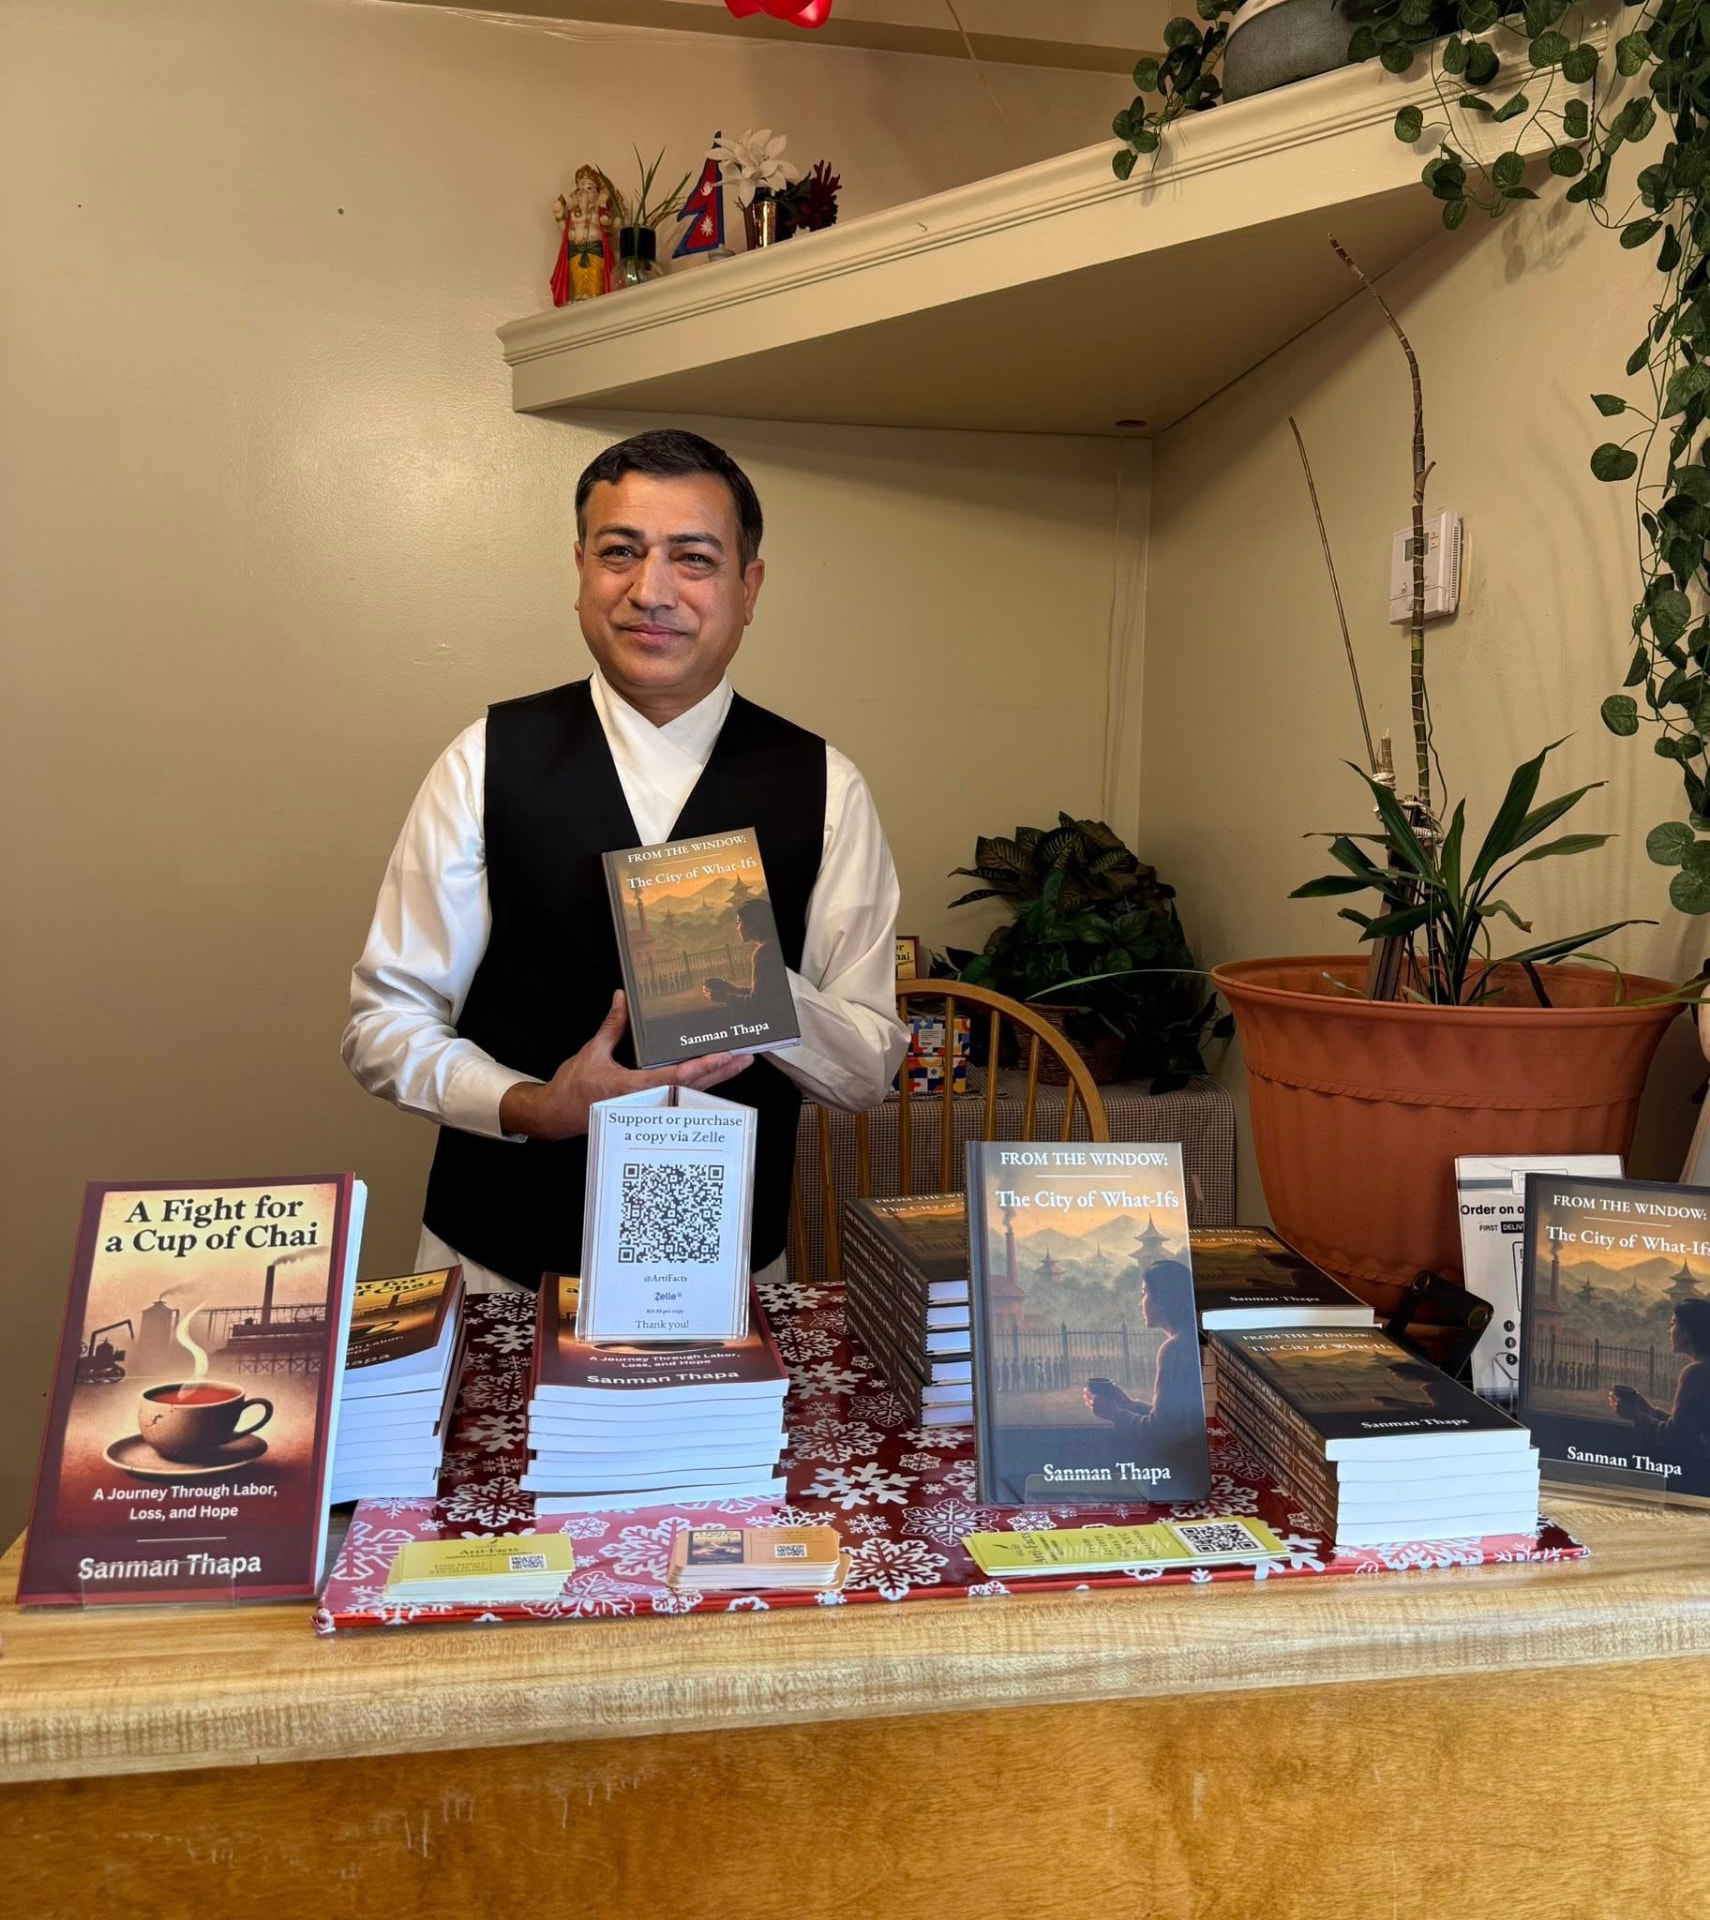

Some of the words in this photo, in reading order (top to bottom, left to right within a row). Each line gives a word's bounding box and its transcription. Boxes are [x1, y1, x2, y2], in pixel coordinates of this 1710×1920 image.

[627, 850, 662, 863] FROM
[664, 845, 689, 857] THE
[691, 835, 747, 852] WINDOW:
[627, 875, 653, 889] The
[655, 872, 683, 885] City
[685, 867, 699, 879] of
[702, 857, 757, 876] What-Ifs
[680, 1030, 728, 1046] Sanman
[730, 1022, 770, 1036] Thapa
[608, 1112, 663, 1127] Support
[666, 1115, 682, 1125] or
[683, 1115, 743, 1128] purchase
[624, 1132, 632, 1141] a
[635, 1133, 668, 1144] copy
[670, 1130, 689, 1142] via
[692, 1131, 726, 1143] Zelle
[1000, 1152, 1048, 1165] FROM
[1052, 1152, 1086, 1165] THE
[1089, 1152, 1168, 1166] WINDOW:
[124, 1200, 152, 1223] A
[161, 1197, 247, 1229] Fight
[254, 1194, 304, 1219] for
[995, 1190, 1030, 1207] The
[1034, 1190, 1073, 1213] City
[1077, 1190, 1097, 1207] of
[1101, 1190, 1180, 1208] What-Ifs
[1460, 1204, 1497, 1215] Order
[1499, 1205, 1515, 1215] on
[1553, 1194, 1596, 1210] FROM
[1599, 1198, 1632, 1213] THE
[1634, 1202, 1708, 1221] WINDOW:
[1479, 1224, 1499, 1232] FIRST
[1545, 1225, 1577, 1243] The
[1580, 1229, 1615, 1249] City
[1619, 1232, 1638, 1248] of
[105, 1235, 124, 1253] a
[133, 1229, 198, 1258] Cup
[205, 1225, 242, 1250] of
[245, 1222, 318, 1248] Chai
[635, 1320, 666, 1329] Thank
[668, 1320, 689, 1331] you!
[1330, 1342, 1393, 1350] What-Ifs
[587, 1375, 671, 1385] Sanman
[675, 1372, 740, 1381] Thapa
[1360, 1419, 1422, 1428] Sanman
[1423, 1418, 1469, 1426] Thapa
[1567, 1446, 1628, 1468] Sanman
[1632, 1454, 1682, 1478] Thapa
[1043, 1463, 1112, 1481] Sanman
[1115, 1461, 1172, 1485] Thapa
[93, 1488, 104, 1501] A
[107, 1486, 168, 1502] Journey
[171, 1483, 230, 1499] Through
[233, 1482, 278, 1497] Labor,
[129, 1507, 166, 1522] Loss,
[169, 1505, 197, 1519] and
[200, 1504, 239, 1520] Hope
[78, 1557, 179, 1580] Sanman
[186, 1552, 262, 1580] Thapa
